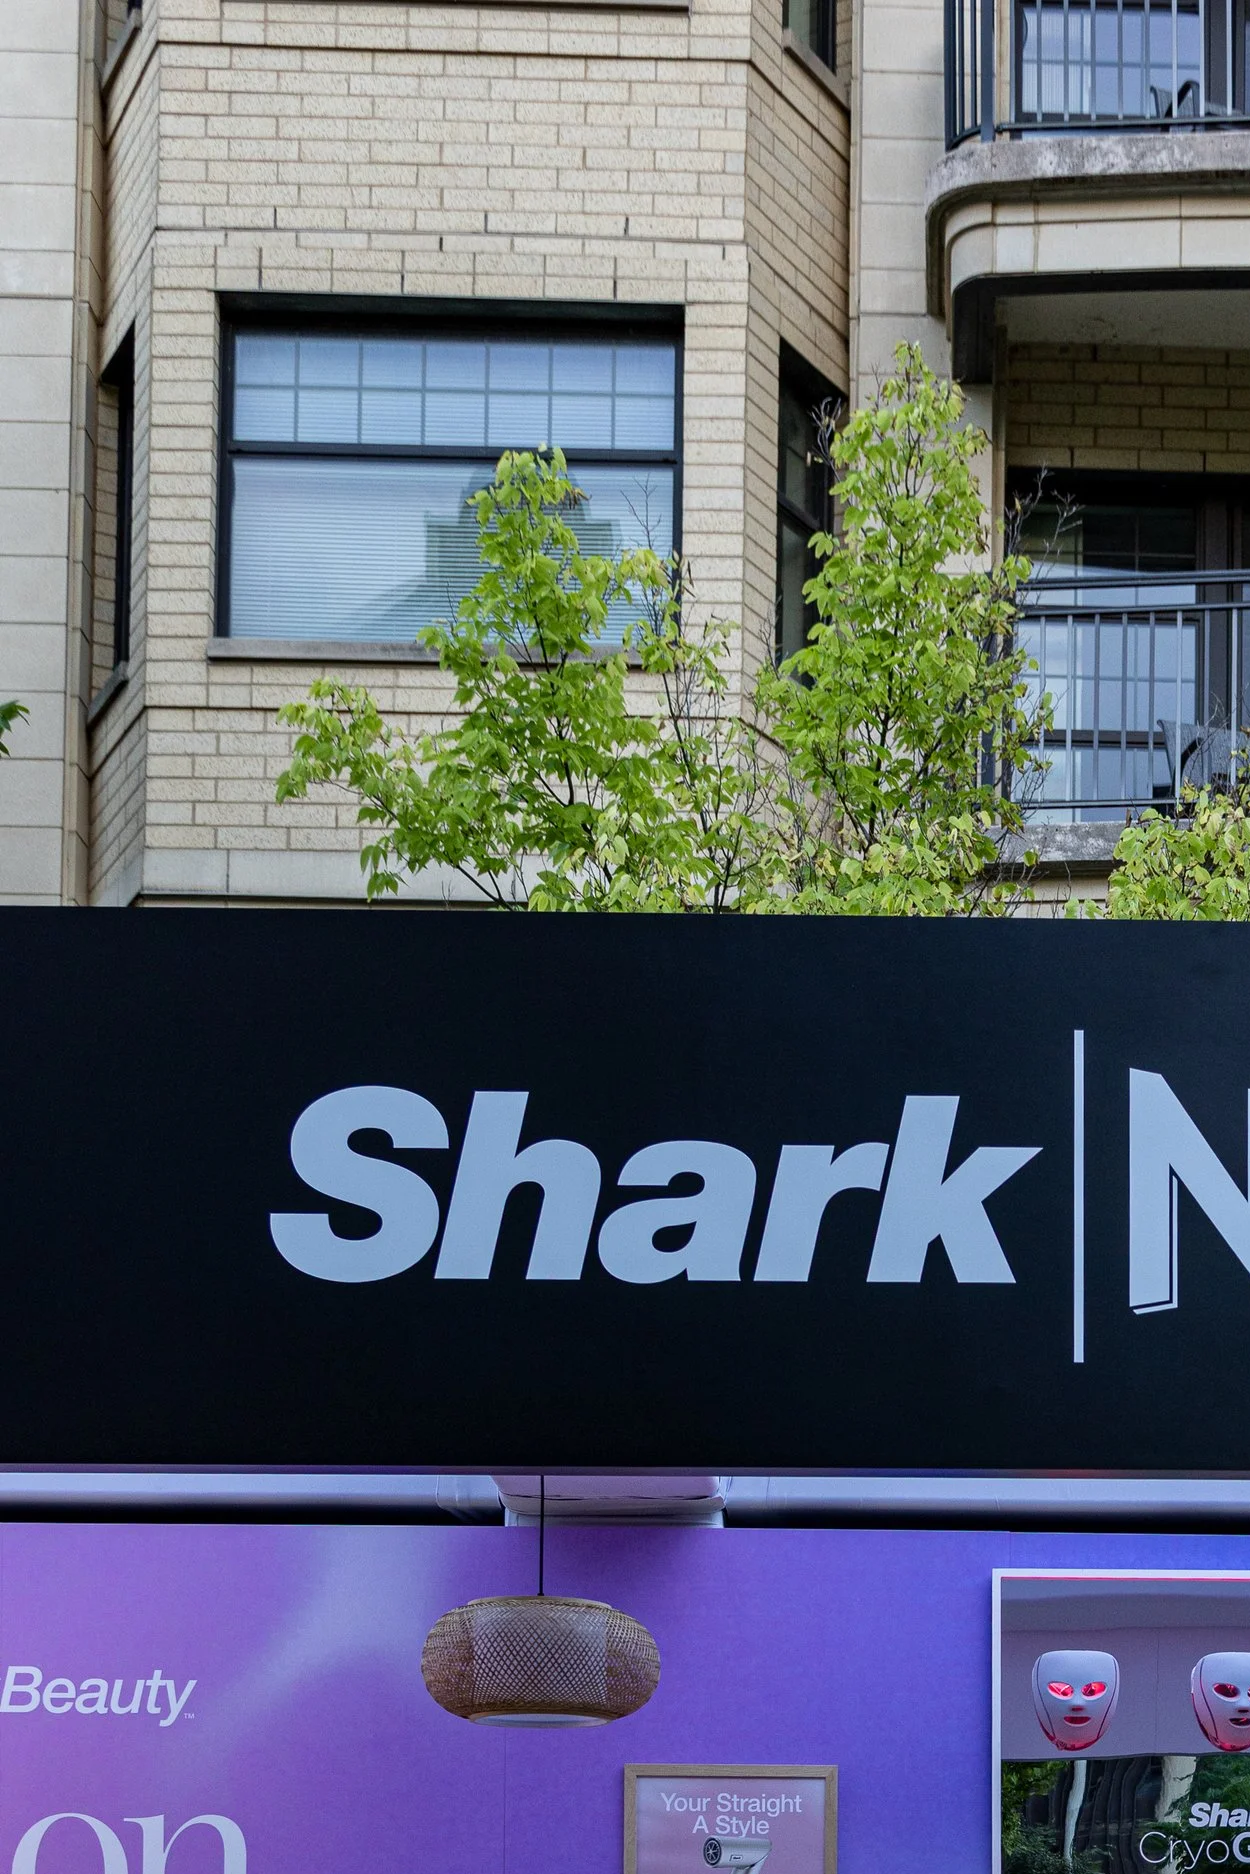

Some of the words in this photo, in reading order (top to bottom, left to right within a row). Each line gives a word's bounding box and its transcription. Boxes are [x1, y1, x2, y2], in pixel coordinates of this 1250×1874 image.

[269, 1085, 1043, 1284] Shark
[0, 1666, 197, 1727] Beauty
[660, 1792, 711, 1812] Your
[716, 1793, 802, 1817] Straight
[692, 1815, 709, 1834] A
[715, 1815, 770, 1838] Style
